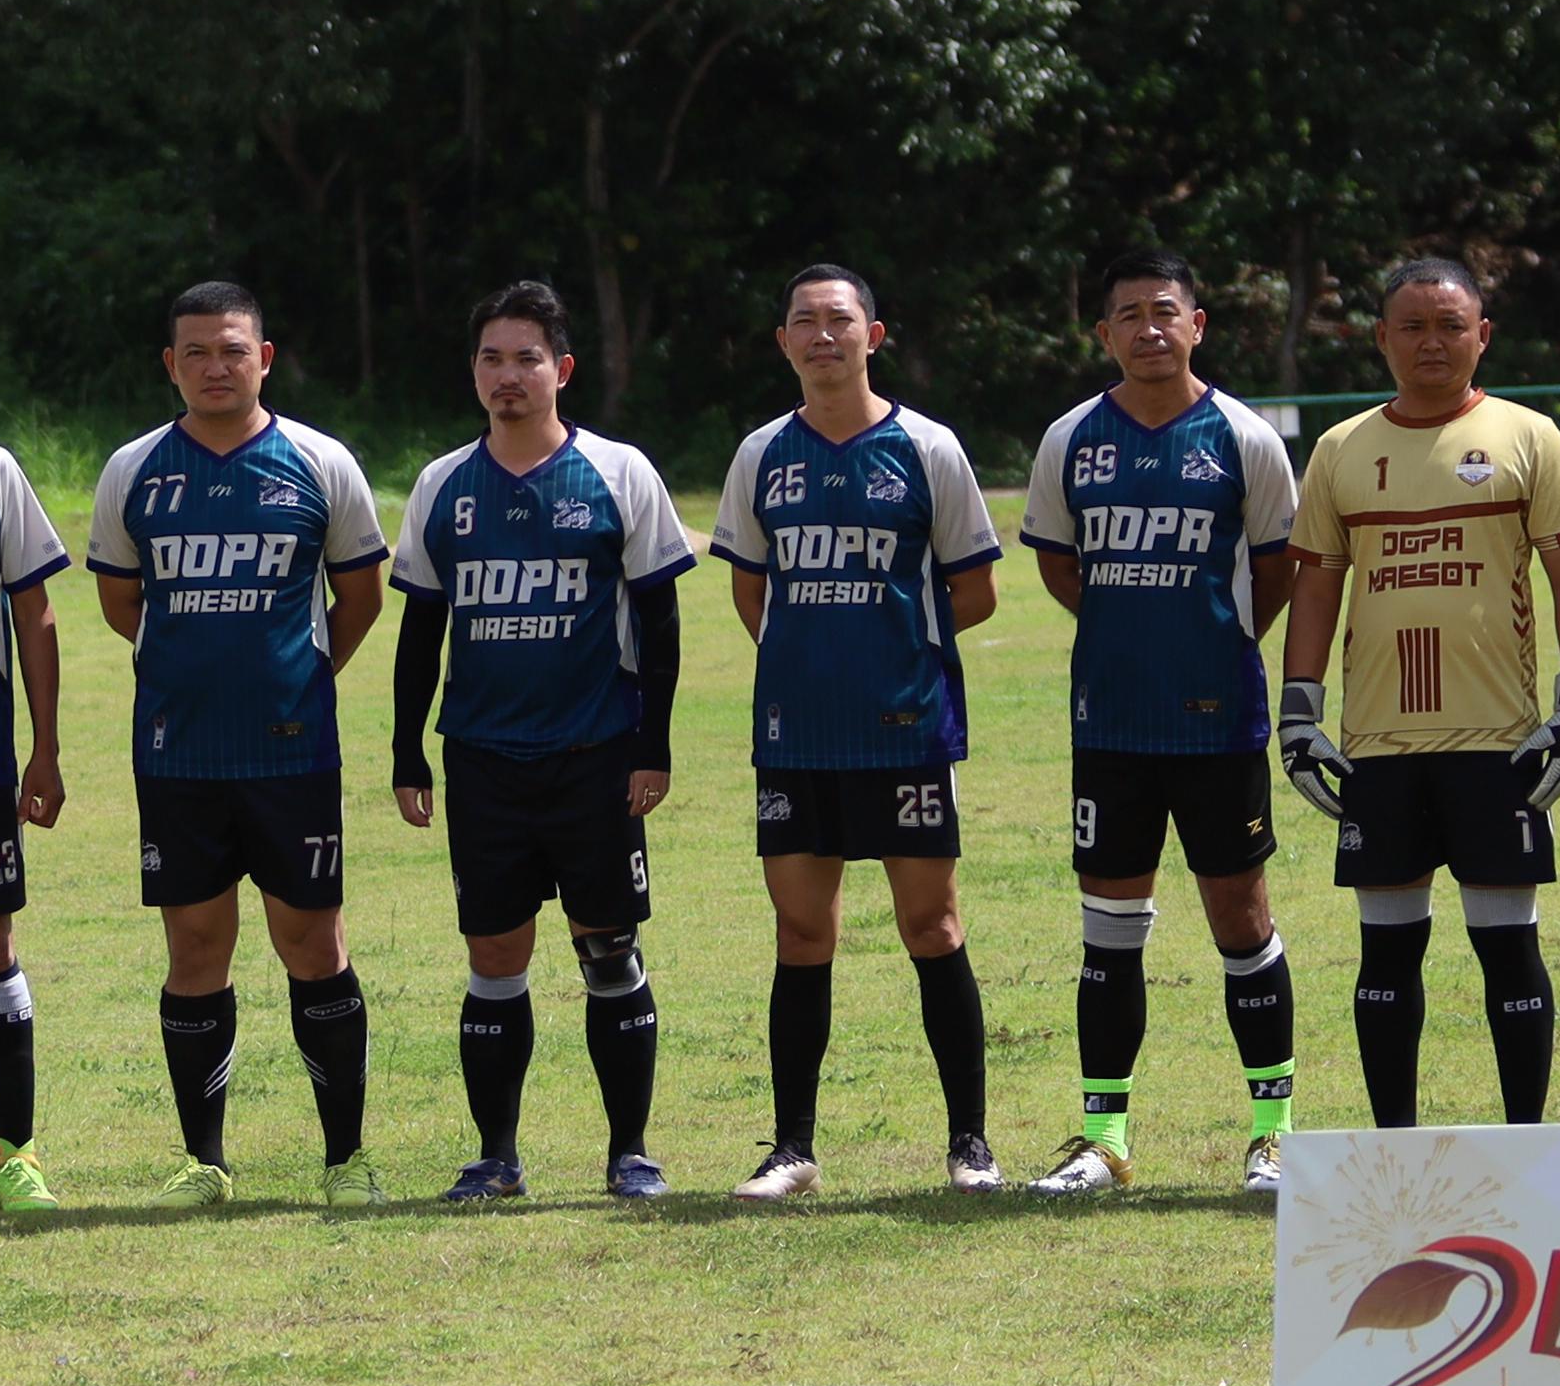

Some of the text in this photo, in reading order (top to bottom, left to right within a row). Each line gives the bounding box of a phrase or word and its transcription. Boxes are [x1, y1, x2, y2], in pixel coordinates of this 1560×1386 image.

[765, 462, 806, 508] 25
[1074, 443, 1117, 488] 69
[1374, 456, 1391, 492] 1
[143, 476, 187, 517] 77
[454, 495, 476, 536] 8
[773, 525, 899, 572] DOPA
[1081, 505, 1216, 555] DOPA
[149, 533, 299, 581] DOPA
[1088, 562, 1198, 588] MAESOT
[453, 558, 589, 608] DOPA
[787, 580, 886, 605] MAESOT
[469, 614, 577, 642] MAESOT
[896, 784, 942, 827] 25
[1515, 810, 1535, 854] 1
[304, 834, 339, 879] 77
[629, 849, 648, 894] 8
[1082, 968, 1105, 981] GO
[1358, 989, 1394, 1001] EGO
[620, 1013, 655, 1030] EGO
[1238, 995, 1277, 1008] EGO
[1504, 997, 1542, 1013] EGO
[464, 1024, 501, 1034] EGO
